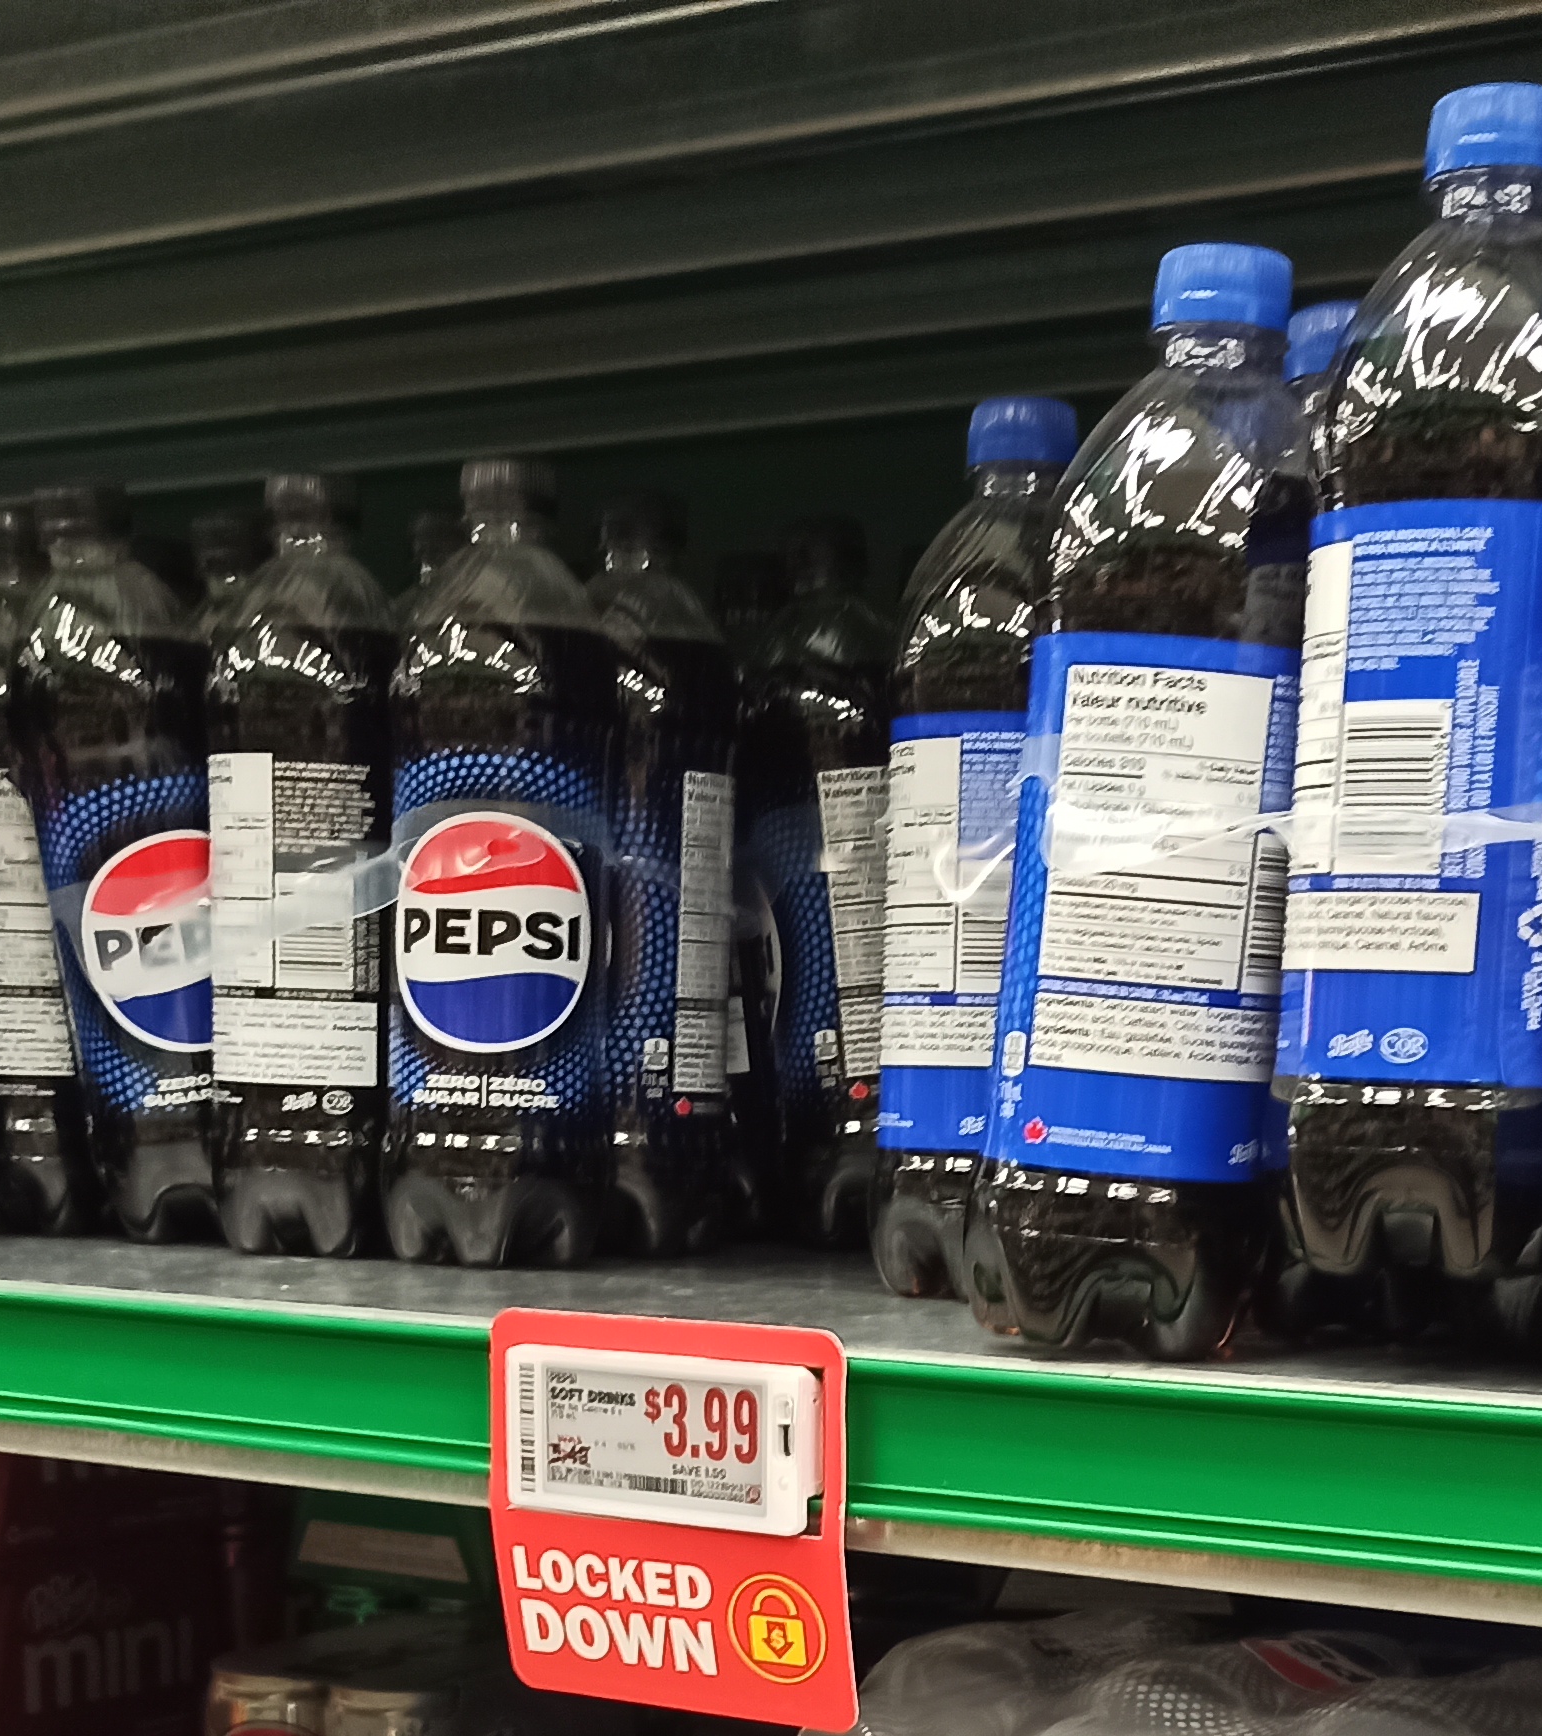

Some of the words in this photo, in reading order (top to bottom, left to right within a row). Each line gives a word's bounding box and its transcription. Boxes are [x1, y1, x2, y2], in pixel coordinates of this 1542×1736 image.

[404, 907, 580, 962] PEPSI
[412, 1089, 480, 1107] SUGAR
[427, 1073, 480, 1090] ZERO
[643, 1382, 759, 1466] $3.99
[511, 1543, 713, 1611] LOCKED
[519, 1597, 719, 1677] DOWN
